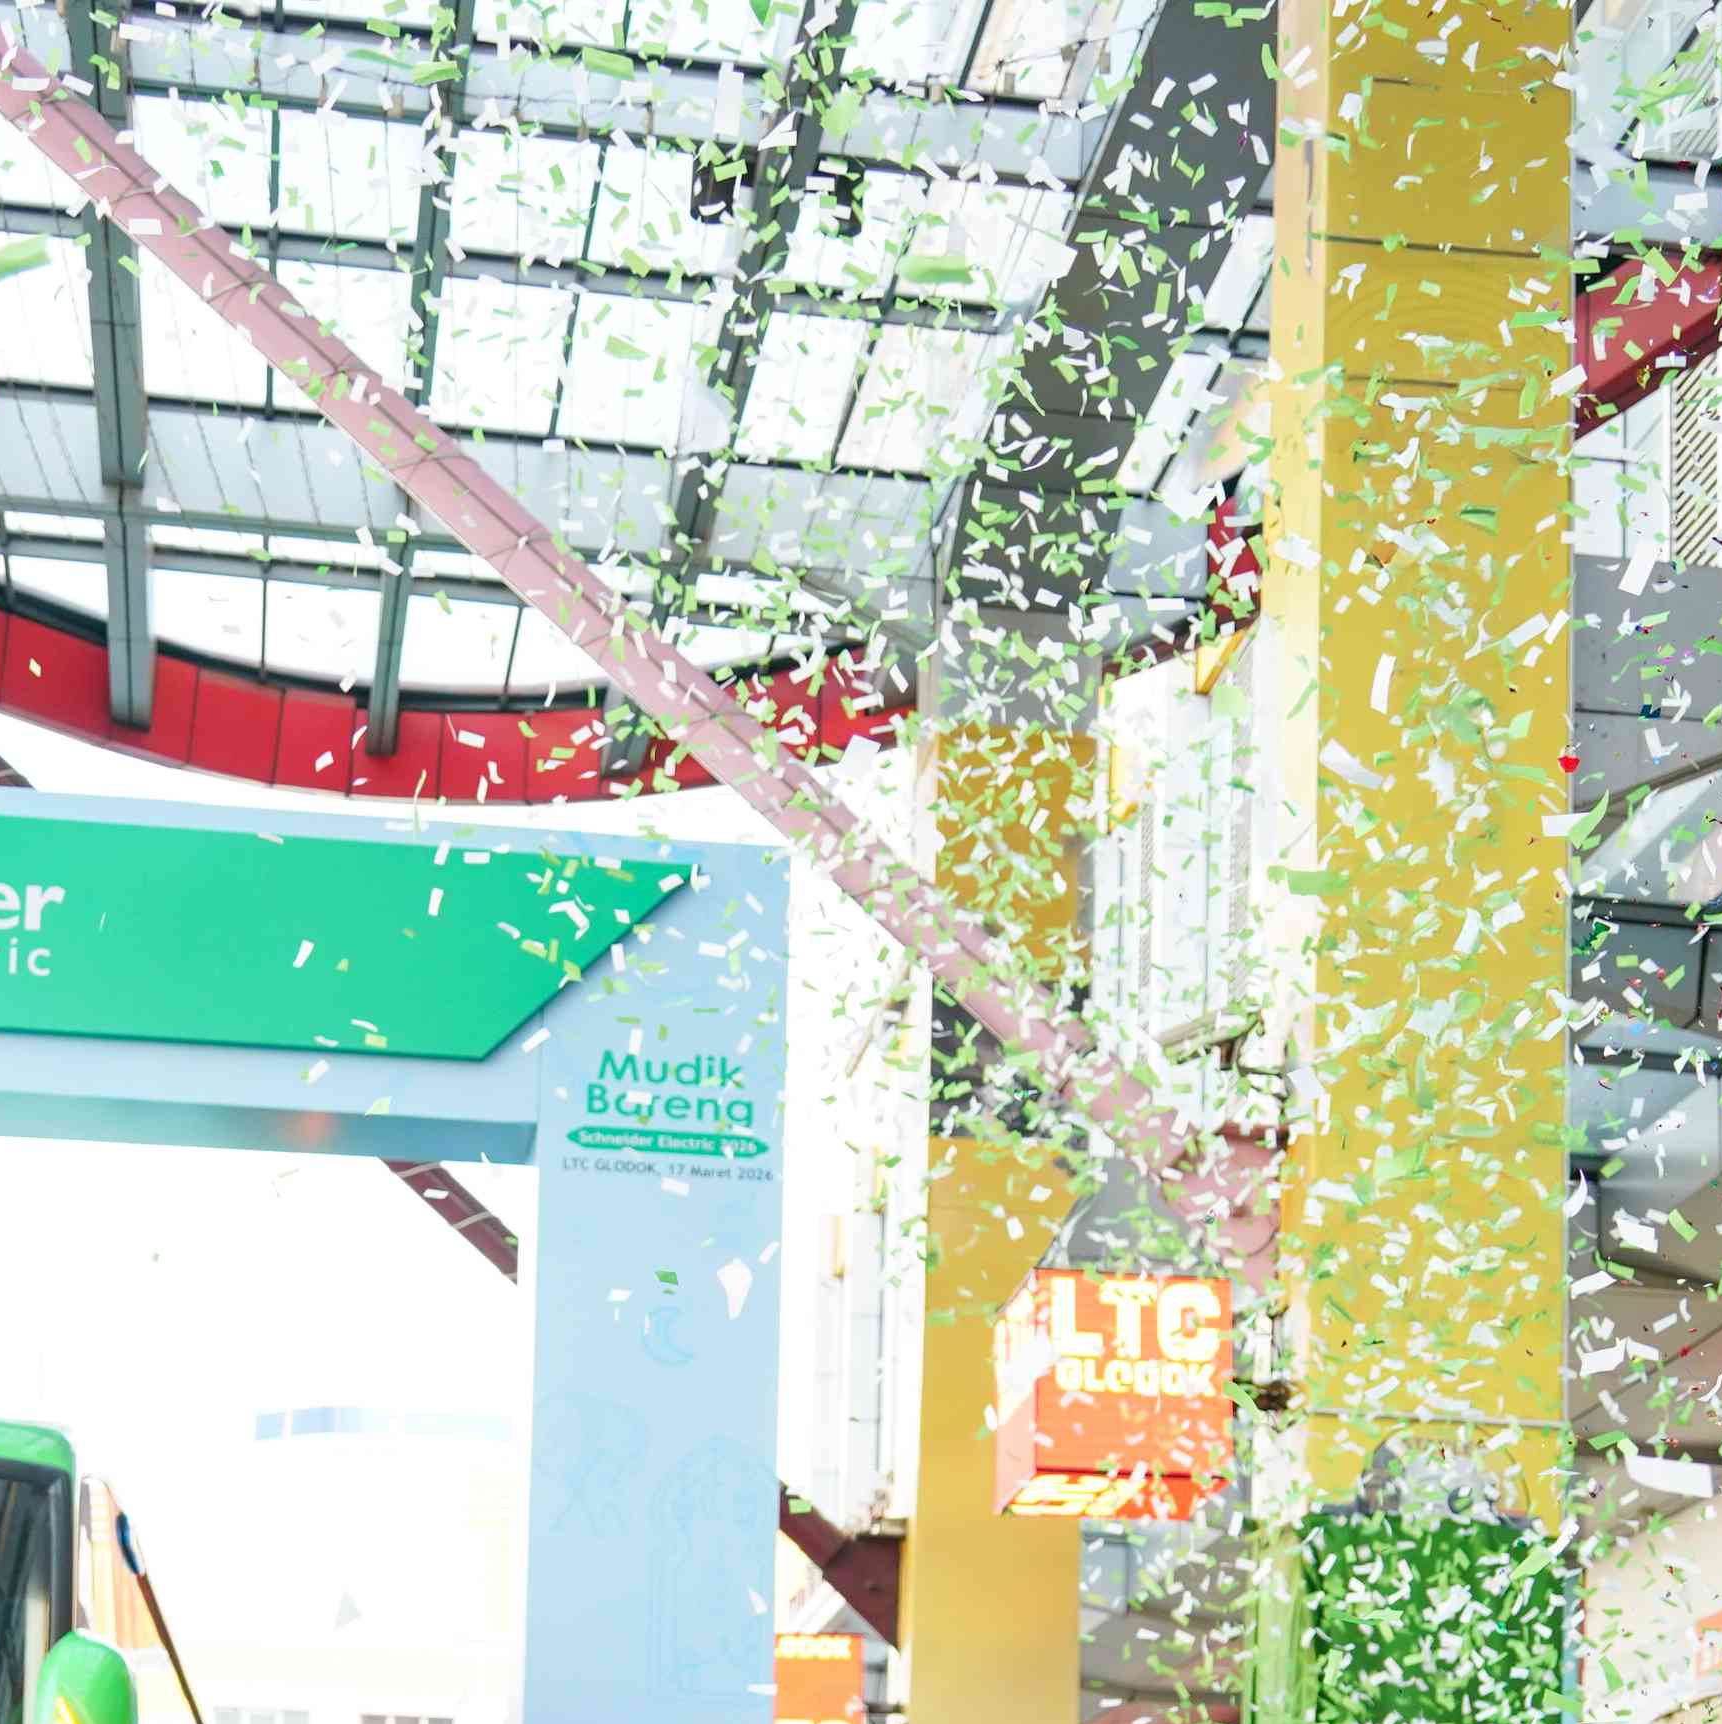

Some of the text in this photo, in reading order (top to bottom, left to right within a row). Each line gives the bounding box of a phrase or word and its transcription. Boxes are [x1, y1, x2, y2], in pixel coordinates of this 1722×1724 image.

[597, 1049, 745, 1089] Mudik
[586, 1083, 755, 1130] Bareng
[578, 1132, 653, 1149] Schneider
[562, 1156, 589, 1171] LTC
[668, 1163, 685, 1176] 17
[690, 1165, 732, 1180] Maret
[1051, 1276, 1222, 1363] LTC
